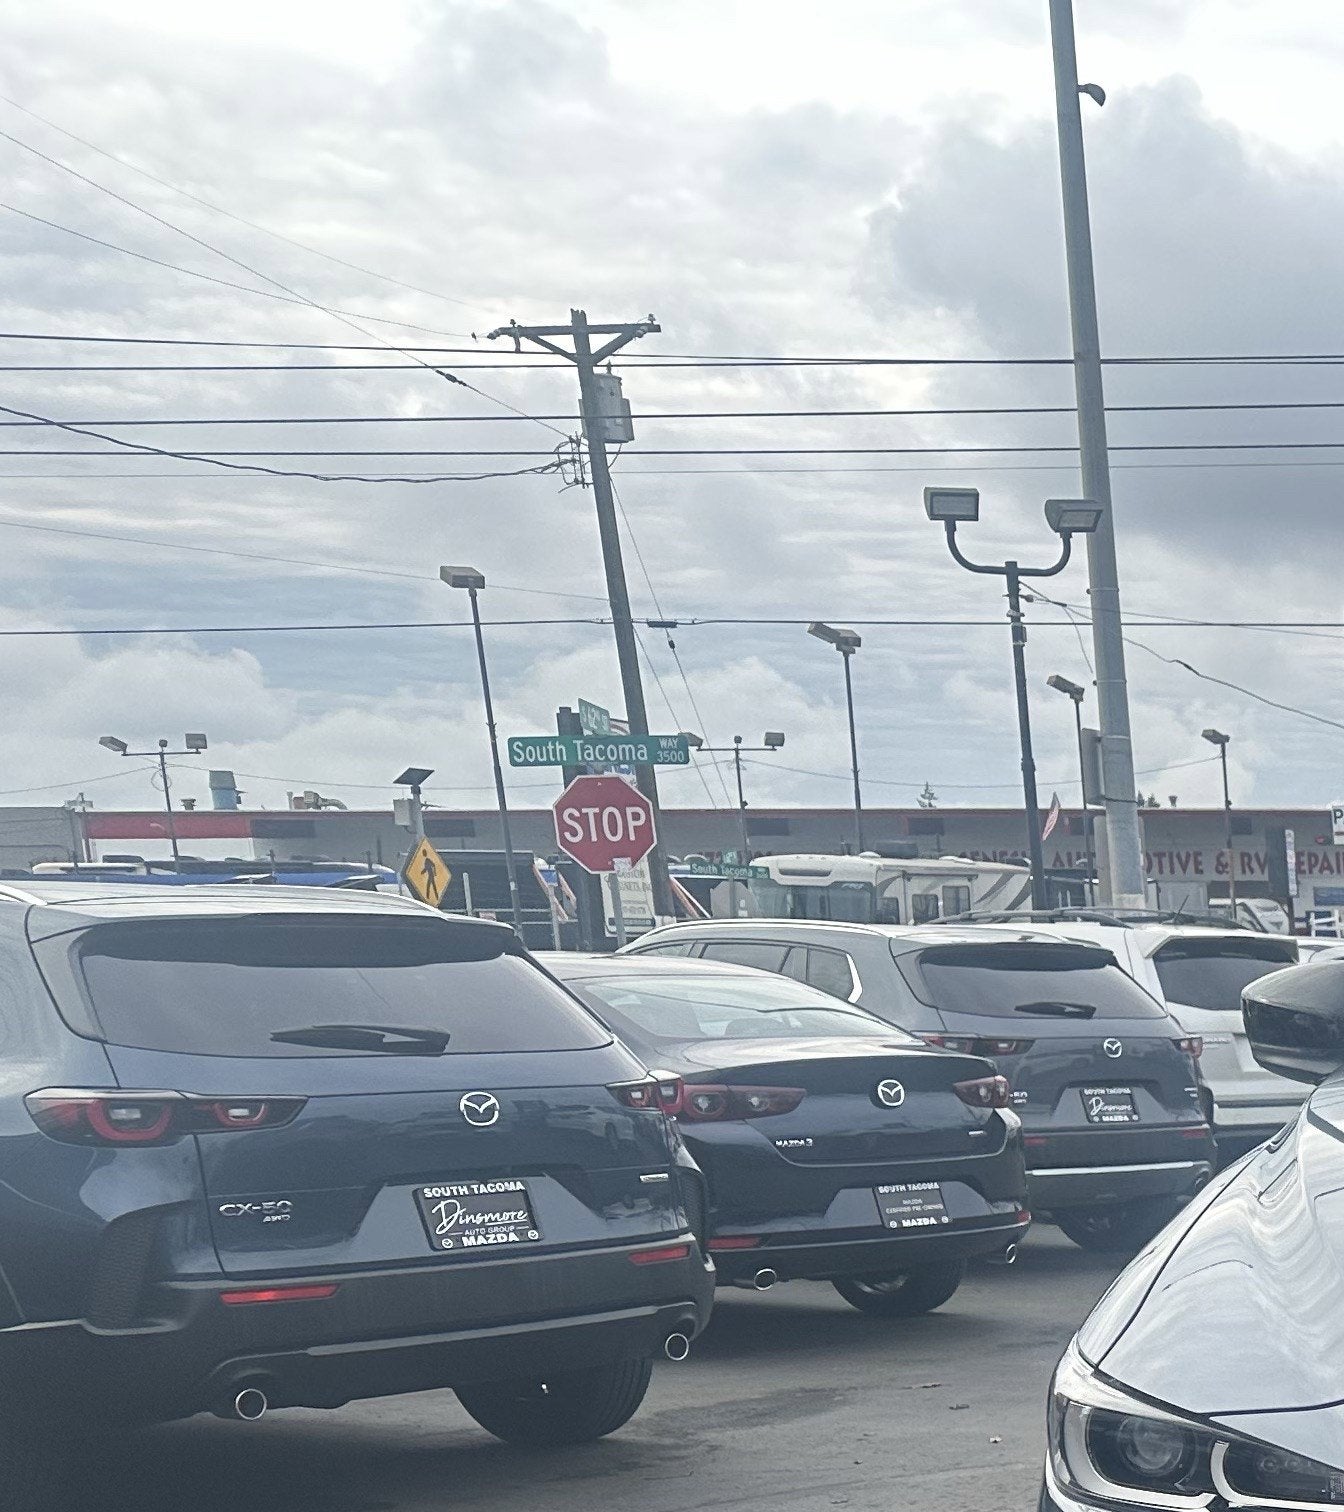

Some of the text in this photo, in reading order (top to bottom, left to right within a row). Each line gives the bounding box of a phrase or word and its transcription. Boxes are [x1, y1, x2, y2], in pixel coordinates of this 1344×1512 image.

[512, 740, 648, 763] South Tacoma
[659, 738, 679, 749] WAY
[657, 750, 684, 763] 3500
[562, 806, 646, 843] STOP
[691, 862, 718, 875] South
[720, 864, 753, 878] Tacoma
[1215, 850, 1229, 876] &
[1240, 851, 1268, 876] RV
[424, 1181, 525, 1199] SOUTH TACOMA
[878, 1184, 906, 1194] SOUTH
[219, 1200, 293, 1217] CX-50
[432, 1199, 528, 1235] Dinsmore
[902, 1217, 938, 1227] MAZDA
[465, 1225, 515, 1236] AUTO GROUP
[462, 1232, 520, 1248] MAZDA
